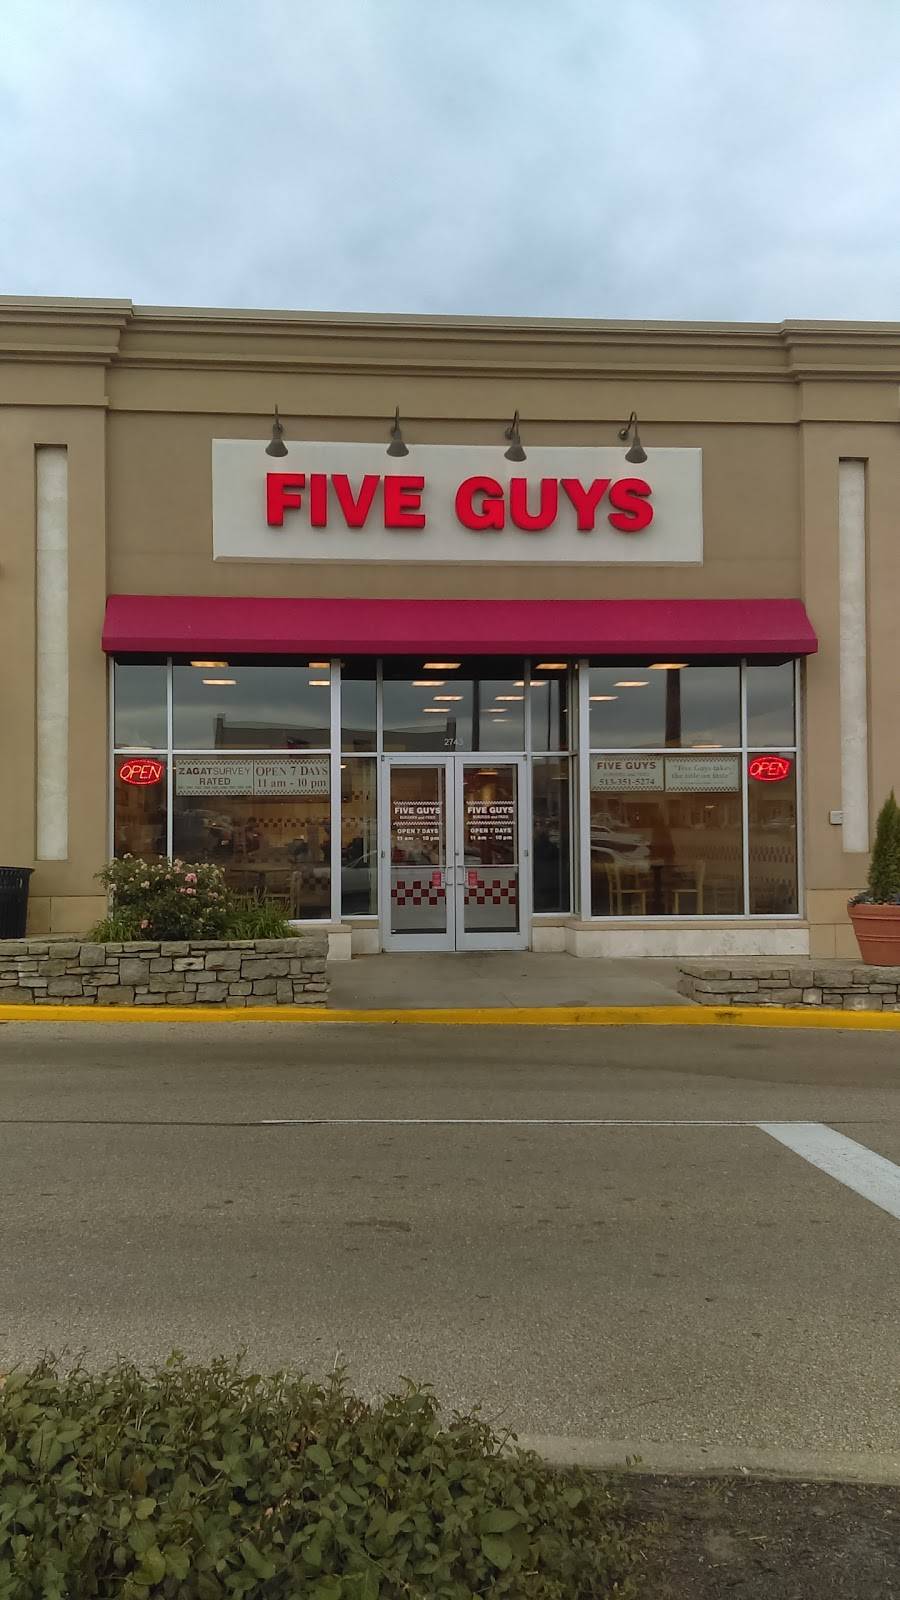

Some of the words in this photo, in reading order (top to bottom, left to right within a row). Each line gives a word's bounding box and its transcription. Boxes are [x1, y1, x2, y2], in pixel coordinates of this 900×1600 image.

[266, 472, 426, 529] FIVE
[455, 475, 654, 533] GUYS
[596, 761, 622, 770] FIVE
[625, 761, 657, 770] GUYS
[749, 762, 789, 777] OPEN
[119, 763, 163, 781] OPEN
[255, 766, 287, 776] OPEN
[291, 766, 296, 776] 7
[300, 766, 328, 776] DAYS
[199, 777, 231, 786] RATED
[257, 779, 267, 788] 11
[270, 780, 286, 788] am
[297, 779, 307, 787] 10
[311, 780, 327, 789] pm
